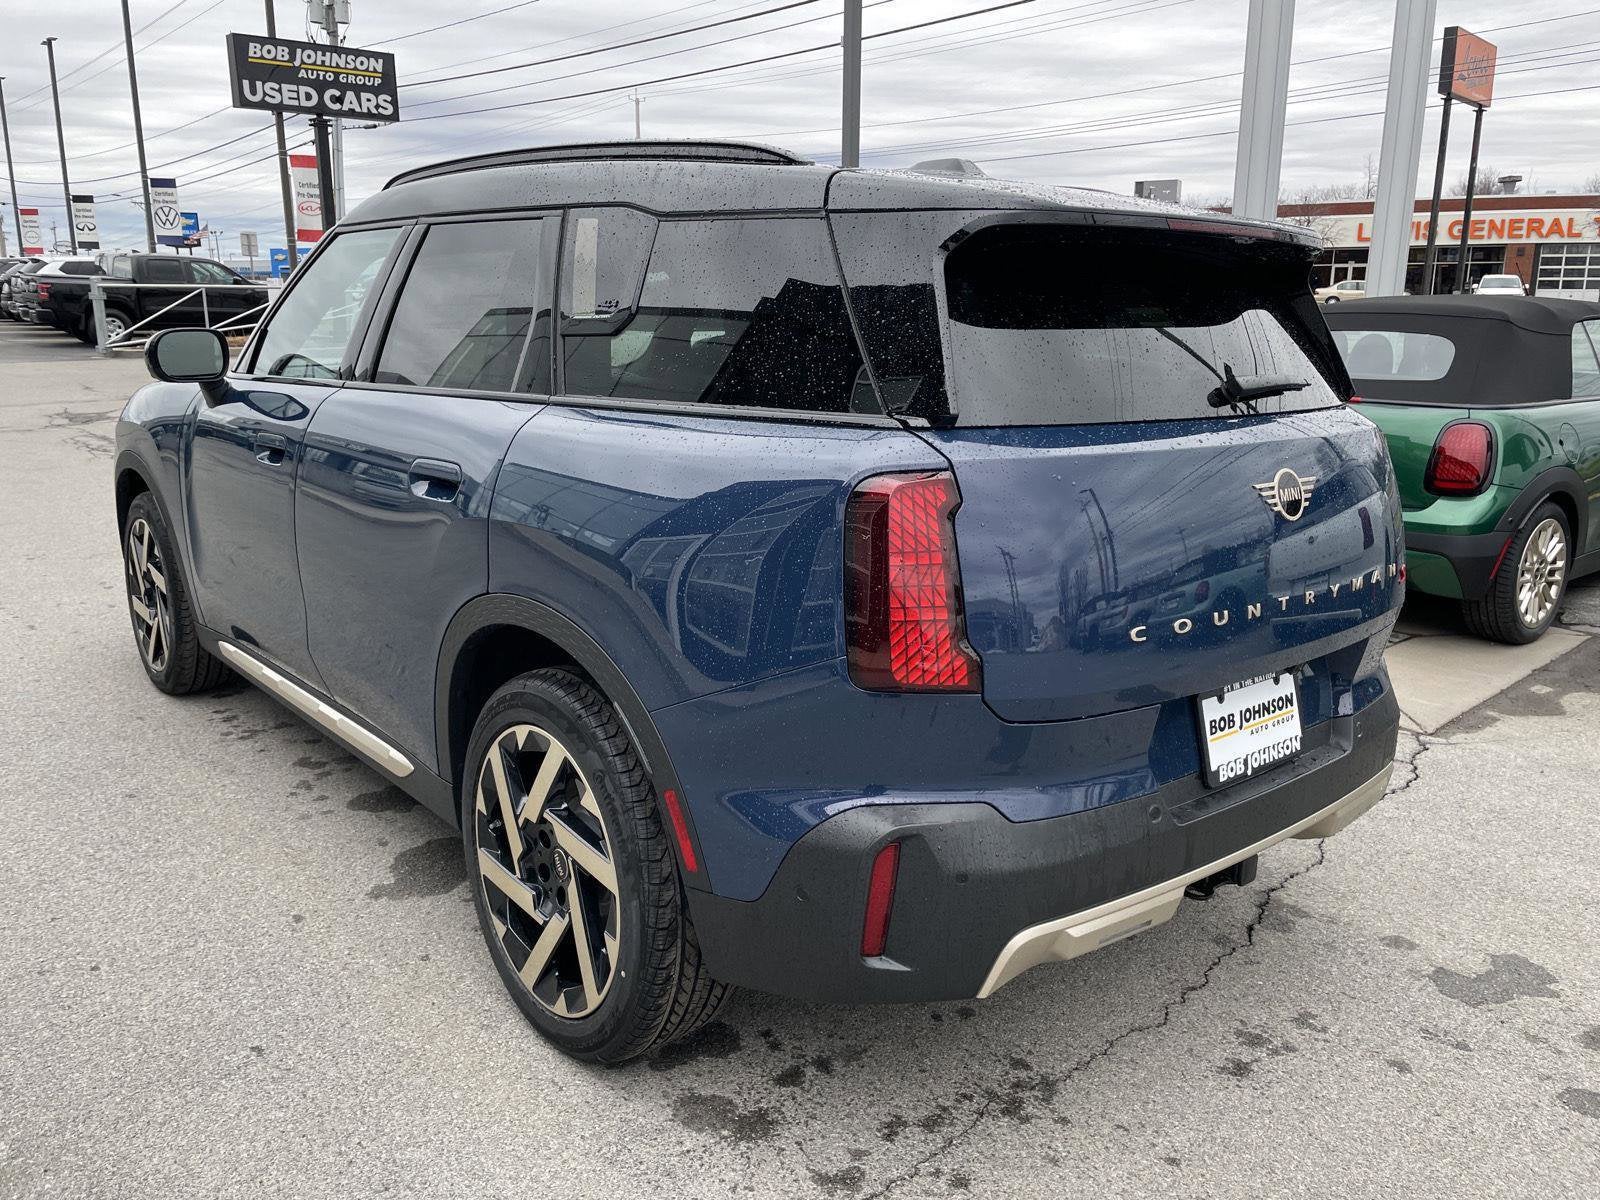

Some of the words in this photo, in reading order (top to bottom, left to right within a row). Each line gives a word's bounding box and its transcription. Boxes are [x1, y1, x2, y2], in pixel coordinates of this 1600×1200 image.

[248, 42, 290, 61] BOB
[293, 48, 384, 73] JOHNSON
[298, 69, 335, 82] AUTO
[339, 74, 382, 87] GROUP
[242, 79, 319, 107] USED
[323, 88, 394, 116] CARS
[1448, 217, 1582, 240] GENERAL
[1280, 486, 1302, 501] MINI
[1129, 563, 1396, 643] COUNTRYMAN
[1241, 678, 1254, 688] THE
[1209, 713, 1236, 736] BOB
[1239, 692, 1295, 731] JOHNSON
[1250, 724, 1269, 736] AUTO
[1272, 714, 1295, 727] GROUP
[1219, 757, 1245, 783] BOB
[1246, 735, 1302, 776] JOHNSON
